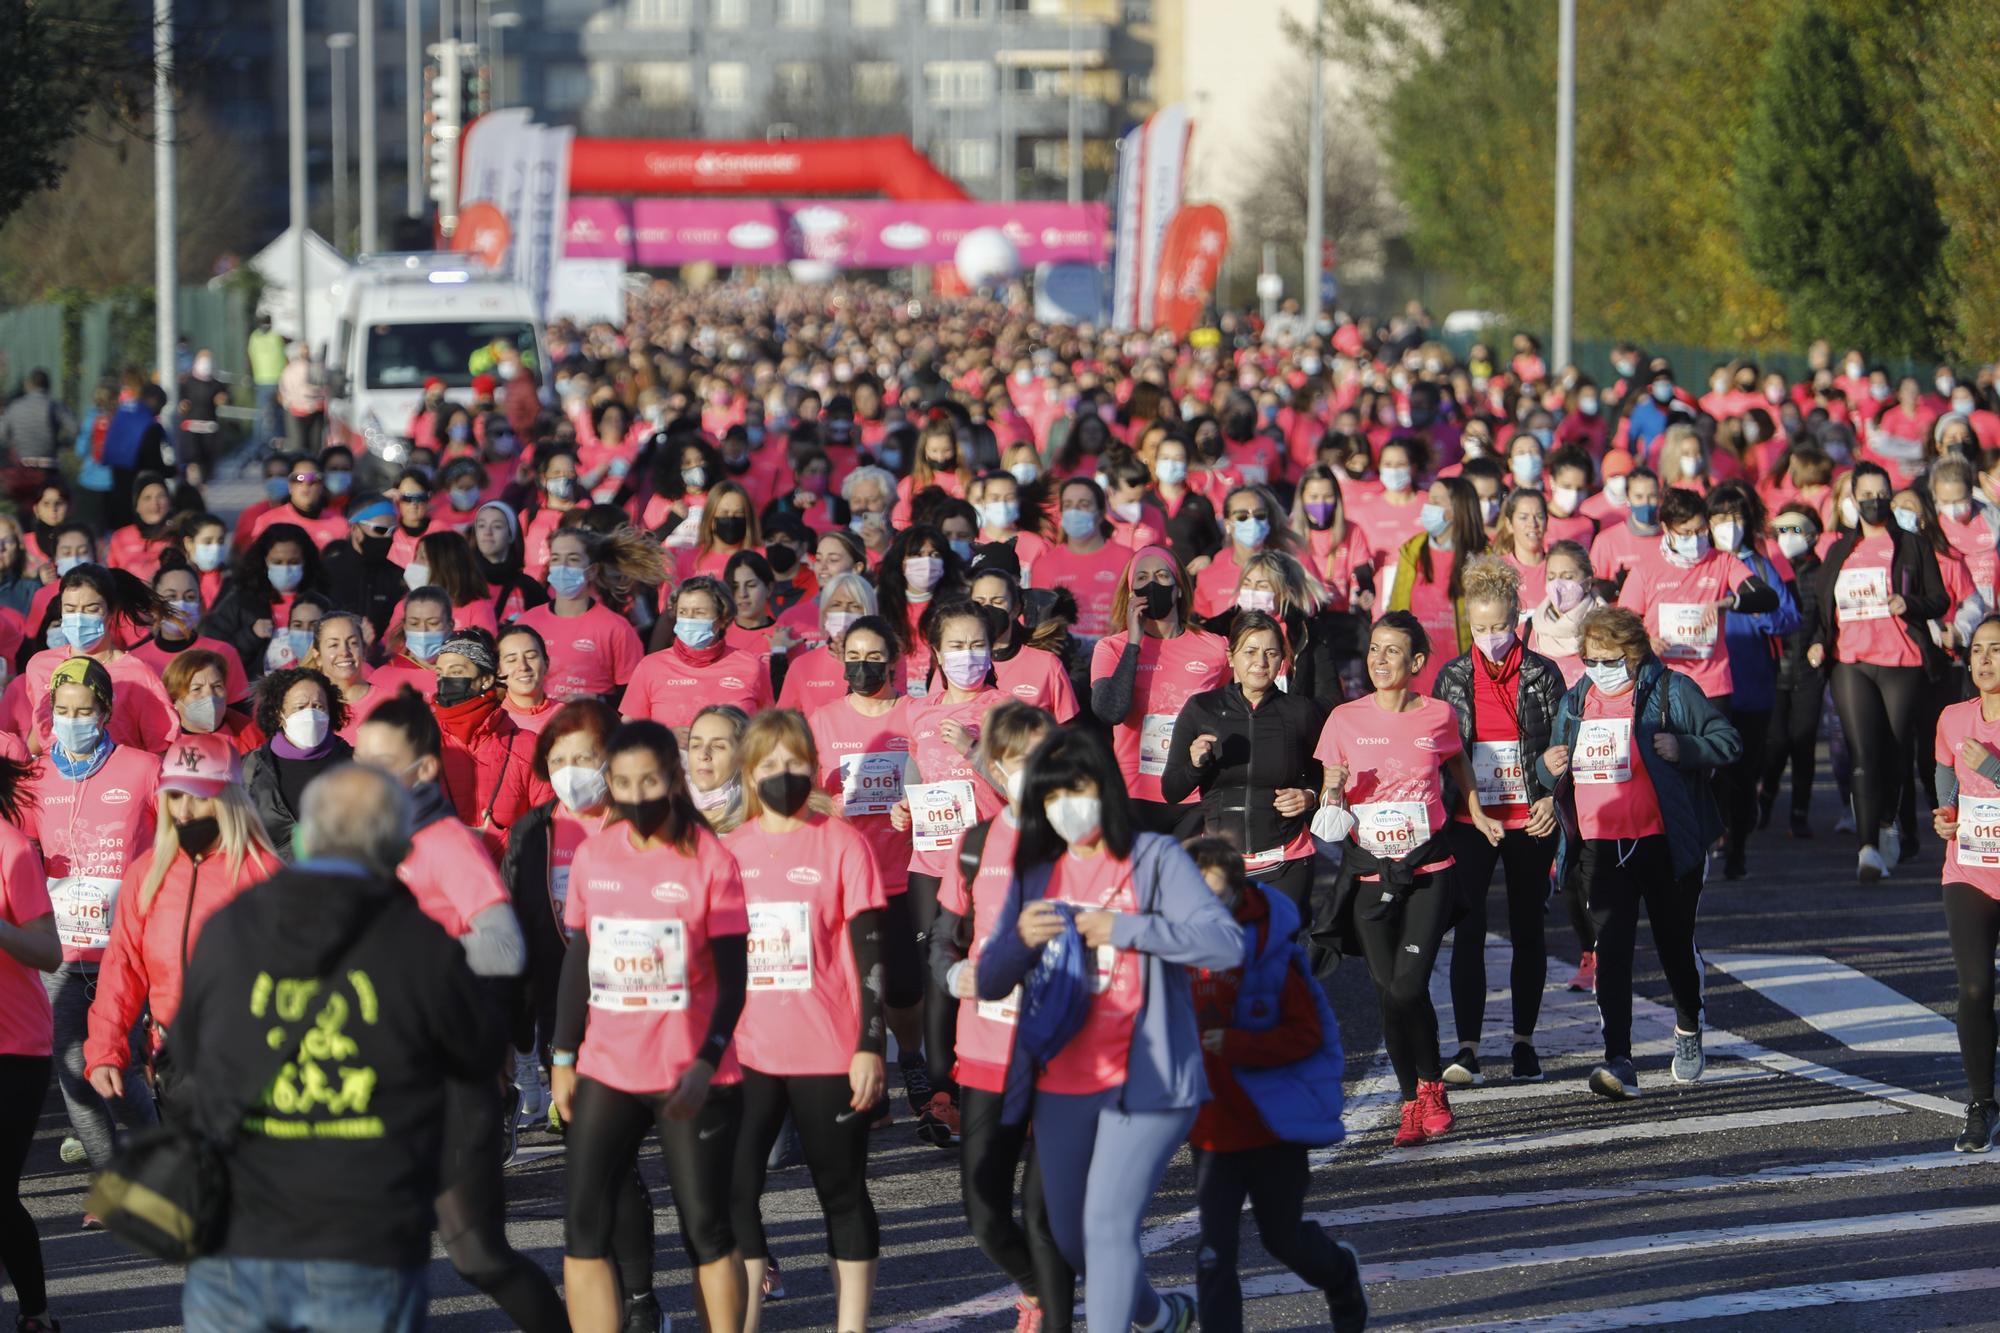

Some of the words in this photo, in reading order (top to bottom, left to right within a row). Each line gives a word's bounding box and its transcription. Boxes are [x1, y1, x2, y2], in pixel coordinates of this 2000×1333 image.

[1357, 737, 1389, 745] OYSHO
[1587, 745, 1610, 757] 016
[951, 768, 973, 776] POR
[1494, 767, 1521, 778] 016
[863, 777, 893, 788] 016
[44, 795, 76, 804] OYSHO
[928, 808, 954, 822] 016
[1376, 829, 1407, 842] 016
[100, 838, 123, 847] POR
[87, 852, 123, 861] TODAS
[740, 868, 760, 878] SHO
[588, 880, 621, 892] OYSHO
[69, 904, 100, 918] 016
[615, 956, 653, 973] 016
